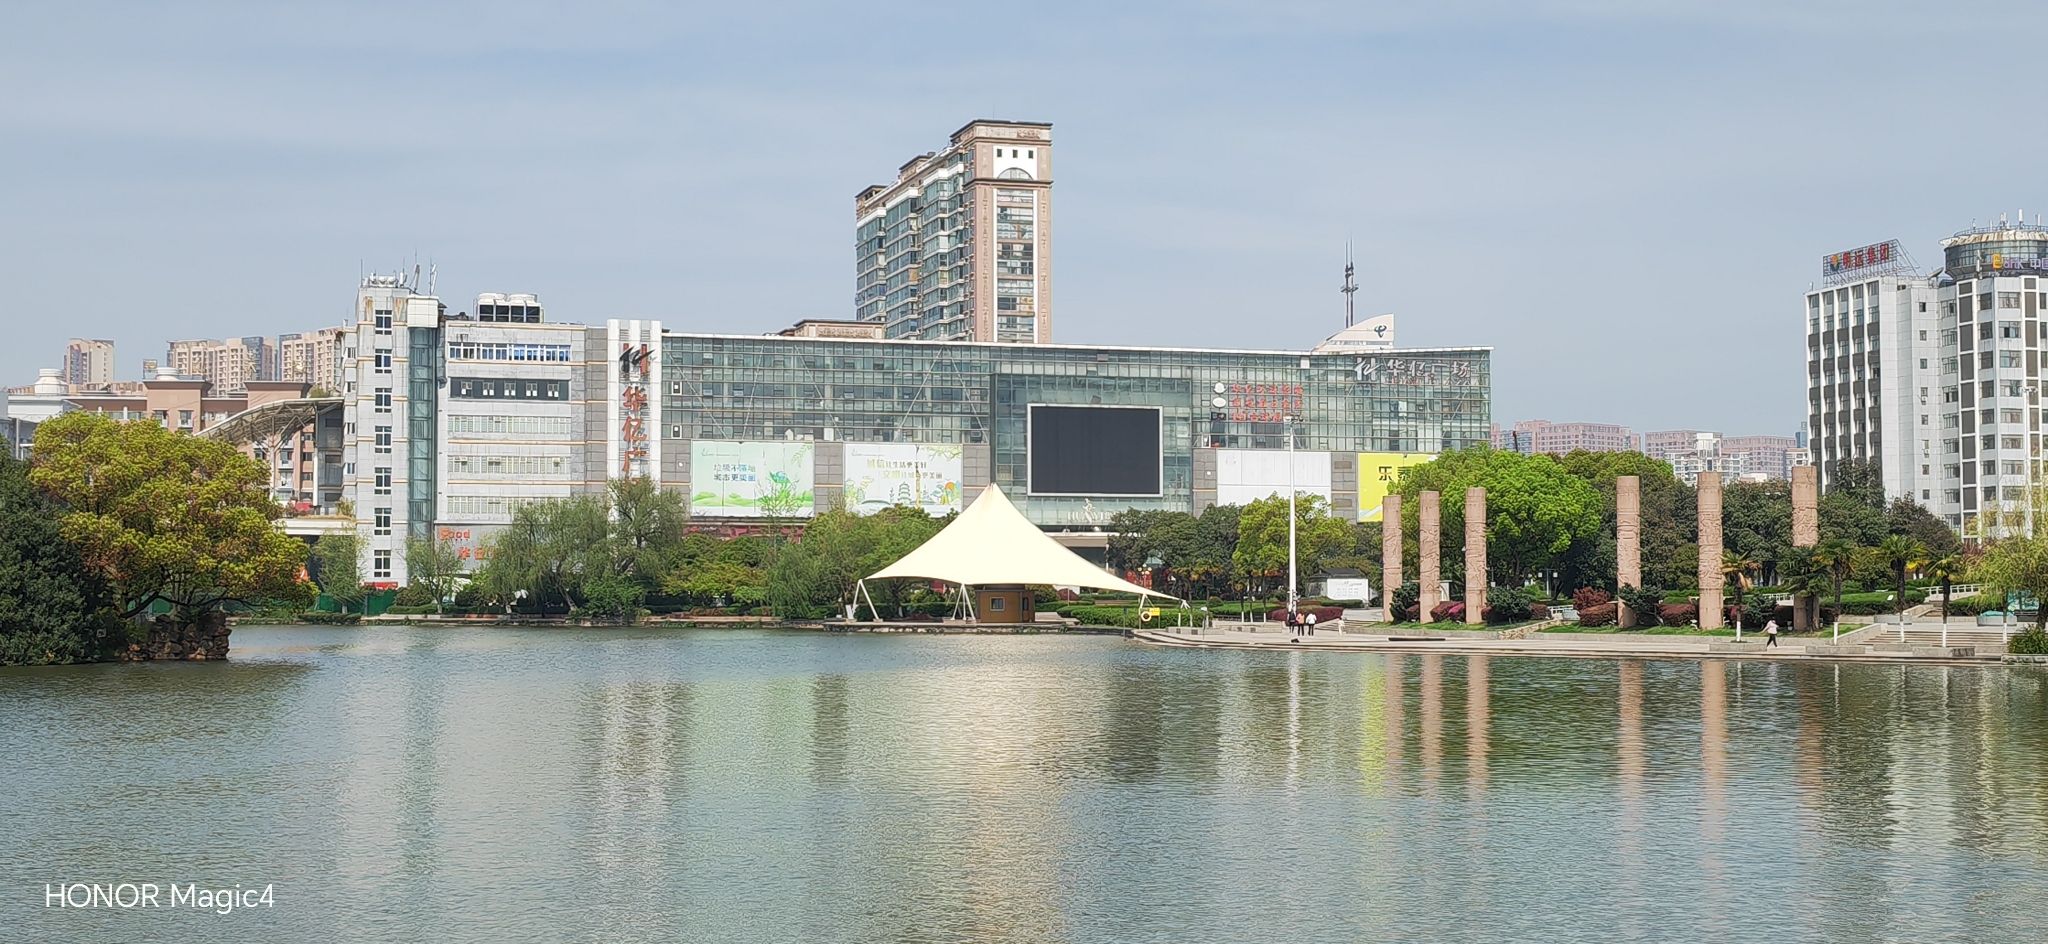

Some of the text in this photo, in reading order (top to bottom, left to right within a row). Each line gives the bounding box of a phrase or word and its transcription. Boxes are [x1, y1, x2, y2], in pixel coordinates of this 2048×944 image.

[1387, 359, 1471, 378] 华亿广场
[622, 385, 648, 490] 华亿广
